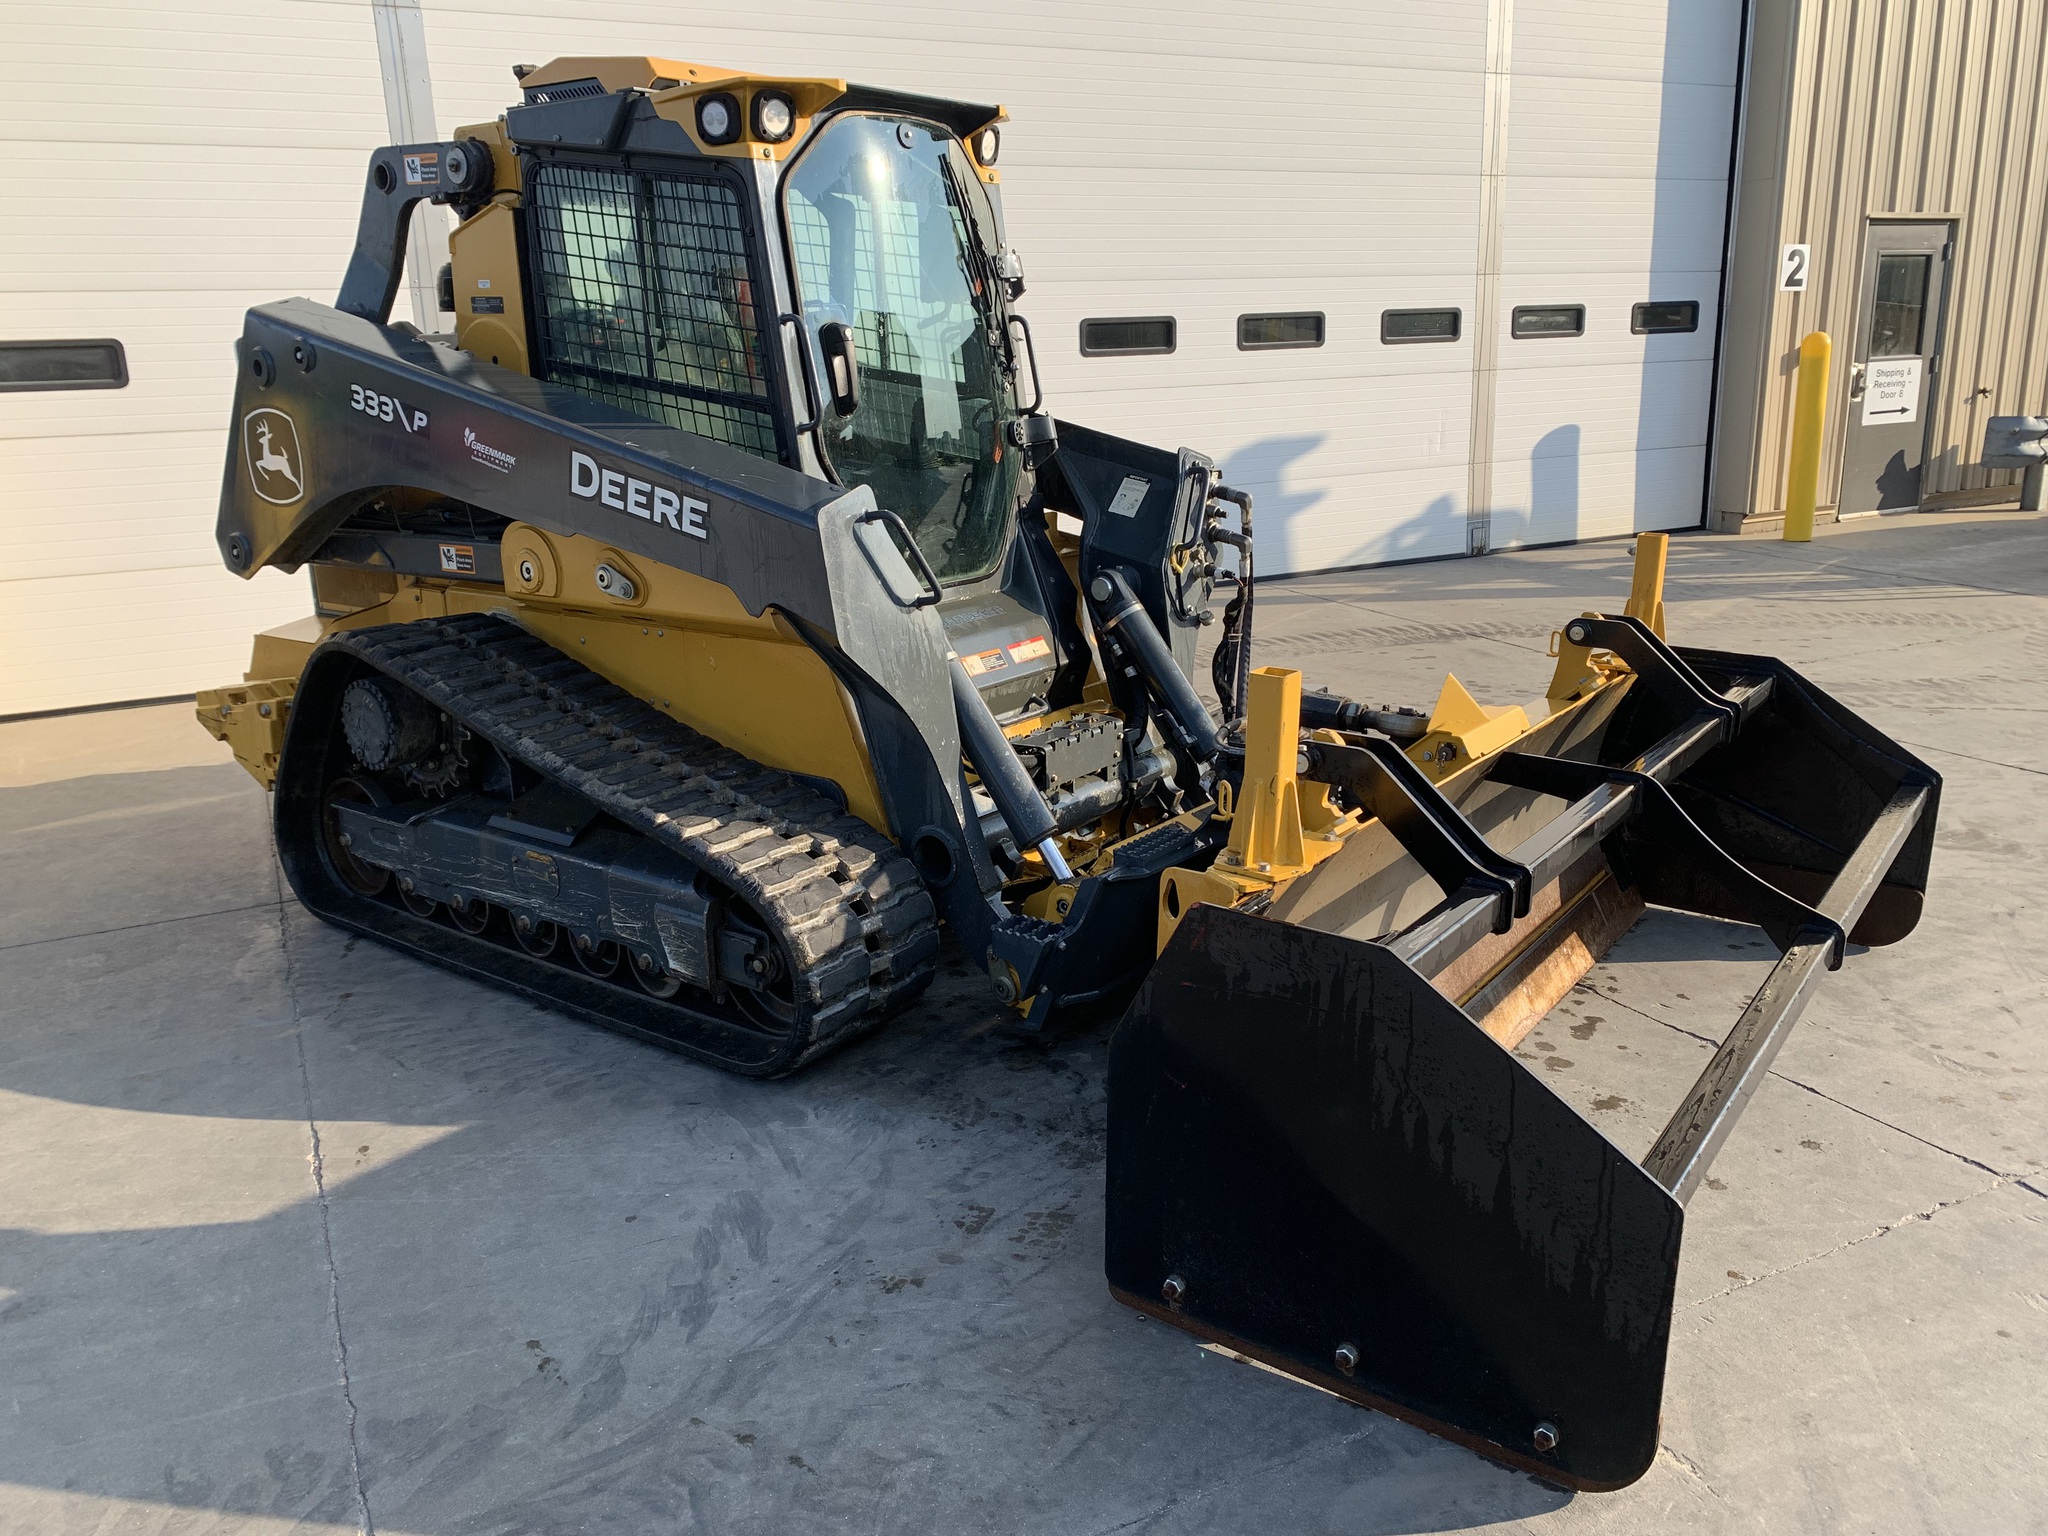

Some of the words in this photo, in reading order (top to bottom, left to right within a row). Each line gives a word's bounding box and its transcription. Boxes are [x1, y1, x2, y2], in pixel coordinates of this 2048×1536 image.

[1784, 248, 1805, 287] 2
[1876, 368, 1905, 378] Shipping
[1907, 367, 1912, 376] &
[1874, 379, 1906, 388] Receiving
[1880, 390, 1897, 399] Door
[1899, 389, 1904, 398] 8
[471, 440, 516, 466] GREENMARK
[571, 450, 708, 540] DEERE
